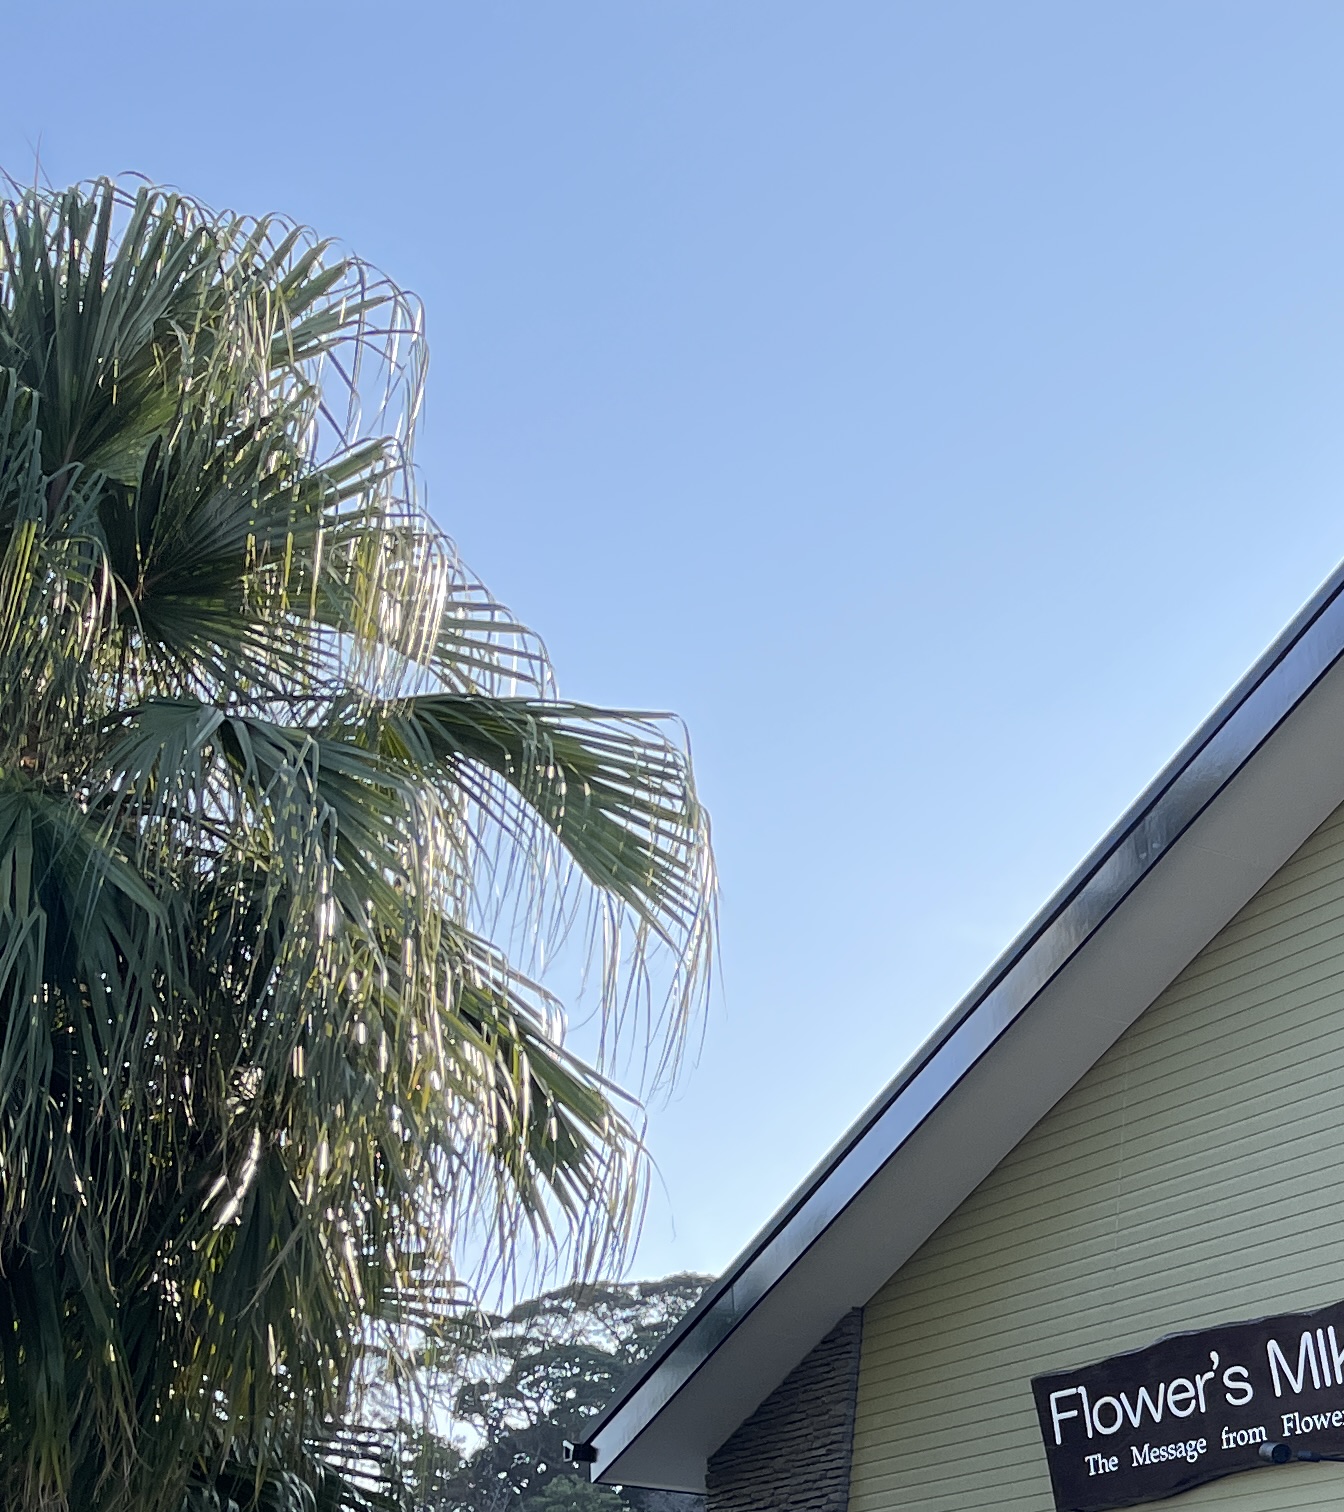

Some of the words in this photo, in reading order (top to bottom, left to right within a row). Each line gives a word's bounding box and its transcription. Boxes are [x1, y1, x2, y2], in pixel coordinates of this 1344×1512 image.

[1049, 1351, 1253, 1445] Flower's
[1085, 1453, 1118, 1476] The
[1131, 1435, 1207, 1467] Message
[1221, 1422, 1267, 1450] from
